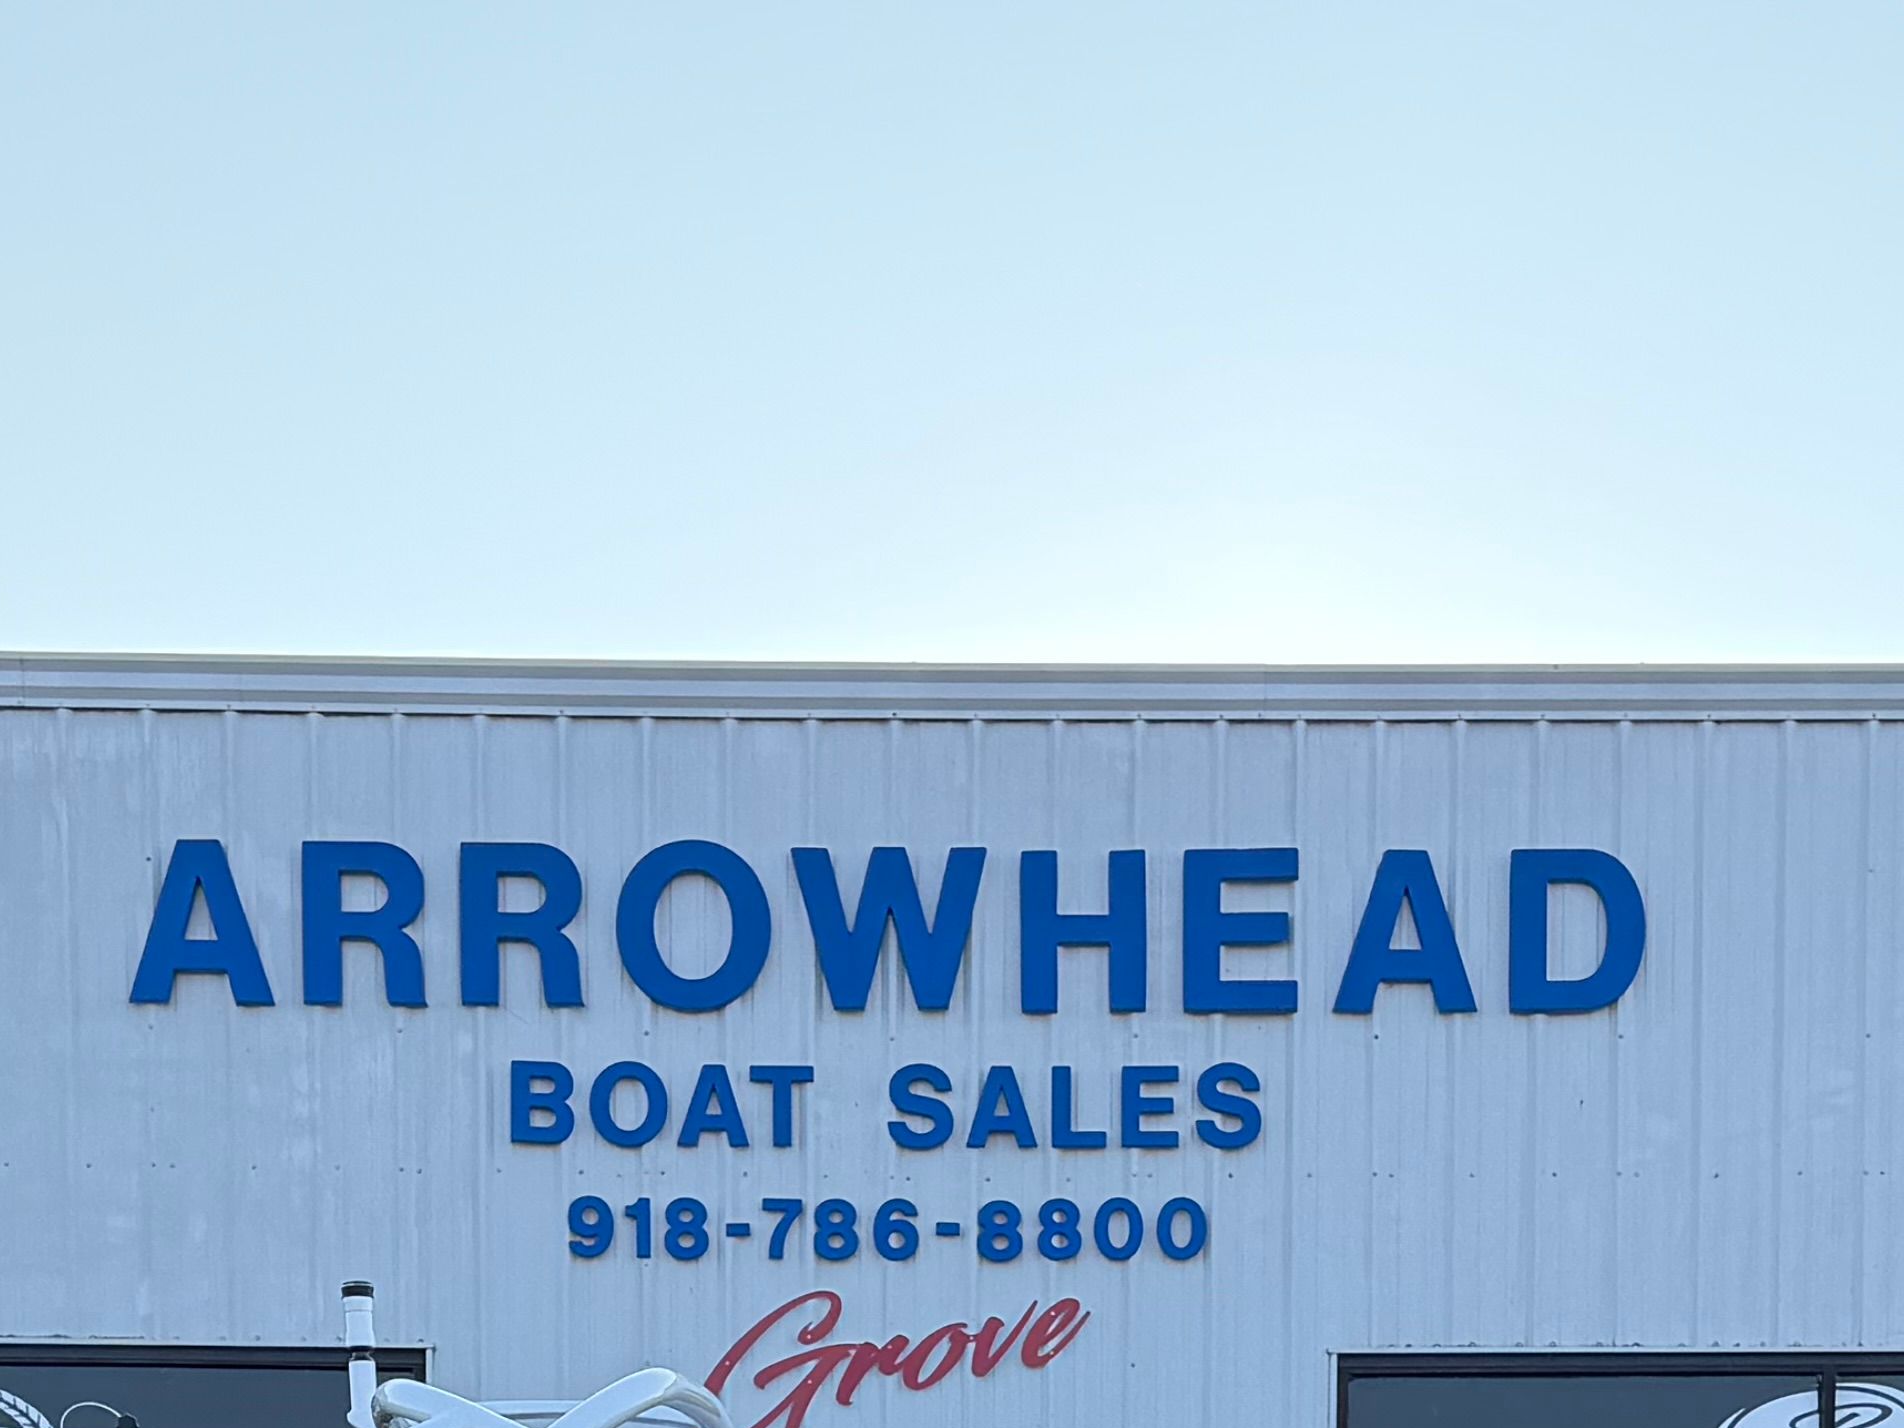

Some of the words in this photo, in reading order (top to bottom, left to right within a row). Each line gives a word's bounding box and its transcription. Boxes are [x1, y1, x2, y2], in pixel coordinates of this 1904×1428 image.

[128, 838, 1647, 1017] ARROWHEAD
[508, 1059, 817, 1149] BOAT
[888, 1060, 1264, 1152] SALES
[564, 1194, 1211, 1264] 918-786-8800
